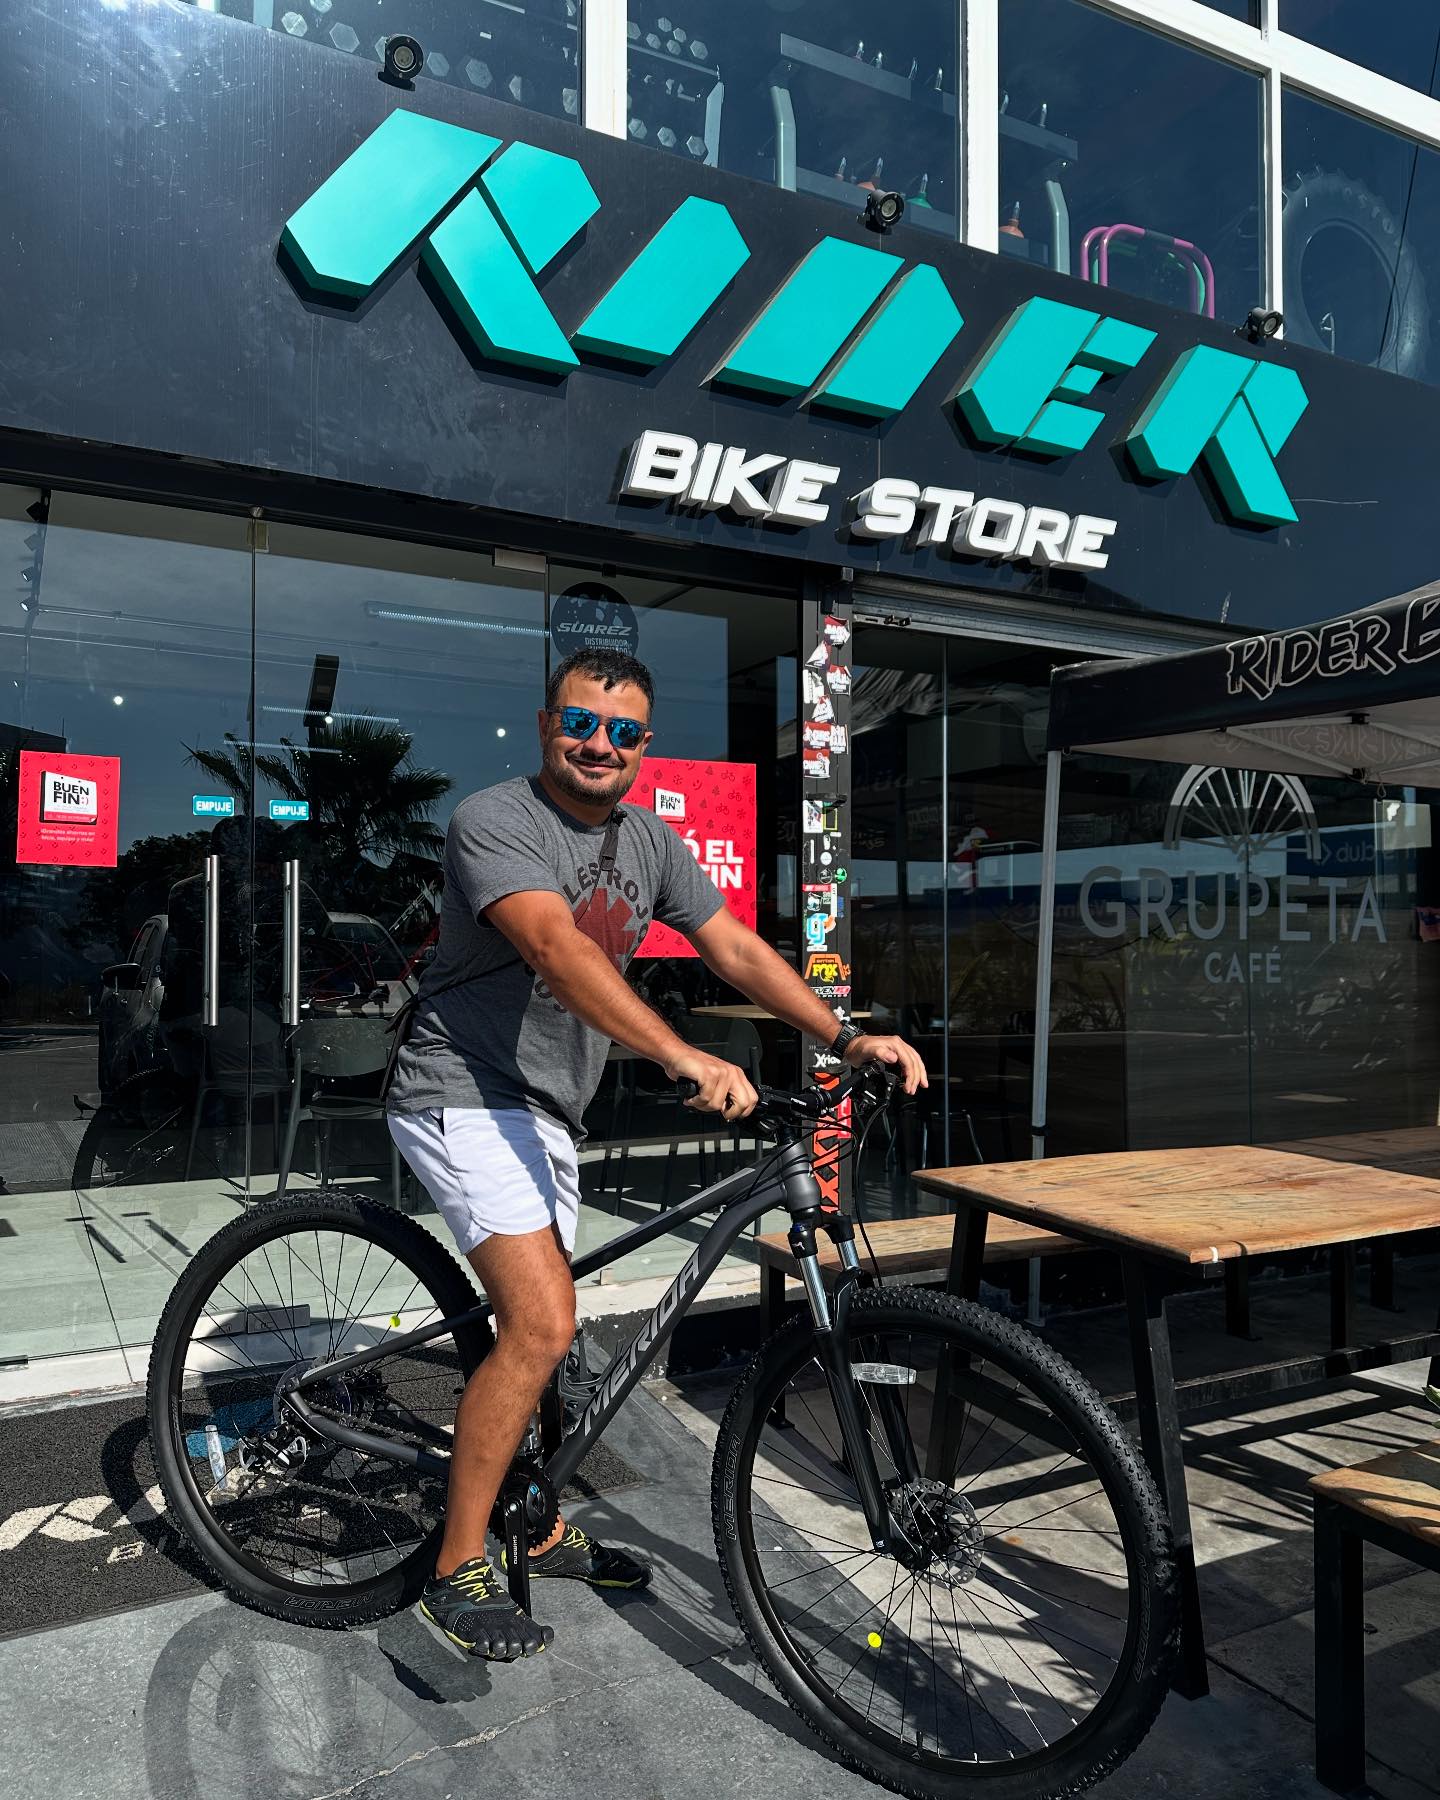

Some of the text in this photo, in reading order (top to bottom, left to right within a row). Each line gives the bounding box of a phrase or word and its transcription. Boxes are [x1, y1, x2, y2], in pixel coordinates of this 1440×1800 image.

[283, 108, 1308, 526] RIDER
[624, 430, 1117, 570] BIKE STORE
[1226, 615, 1396, 700] RIDER
[53, 781, 89, 796] BUEN
[660, 794, 681, 804] BUEN
[196, 800, 232, 812] EMPUJE
[272, 804, 307, 817] EMPUJE
[705, 839, 744, 864] EL
[1080, 865, 1387, 944] GRUPETA
[812, 963, 838, 977] FOX
[1204, 945, 1282, 984] CAFÉ
[584, 1251, 700, 1437] MERIDA
[723, 1433, 741, 1541] MERIDA
[283, 1590, 376, 1611] MERIDA
